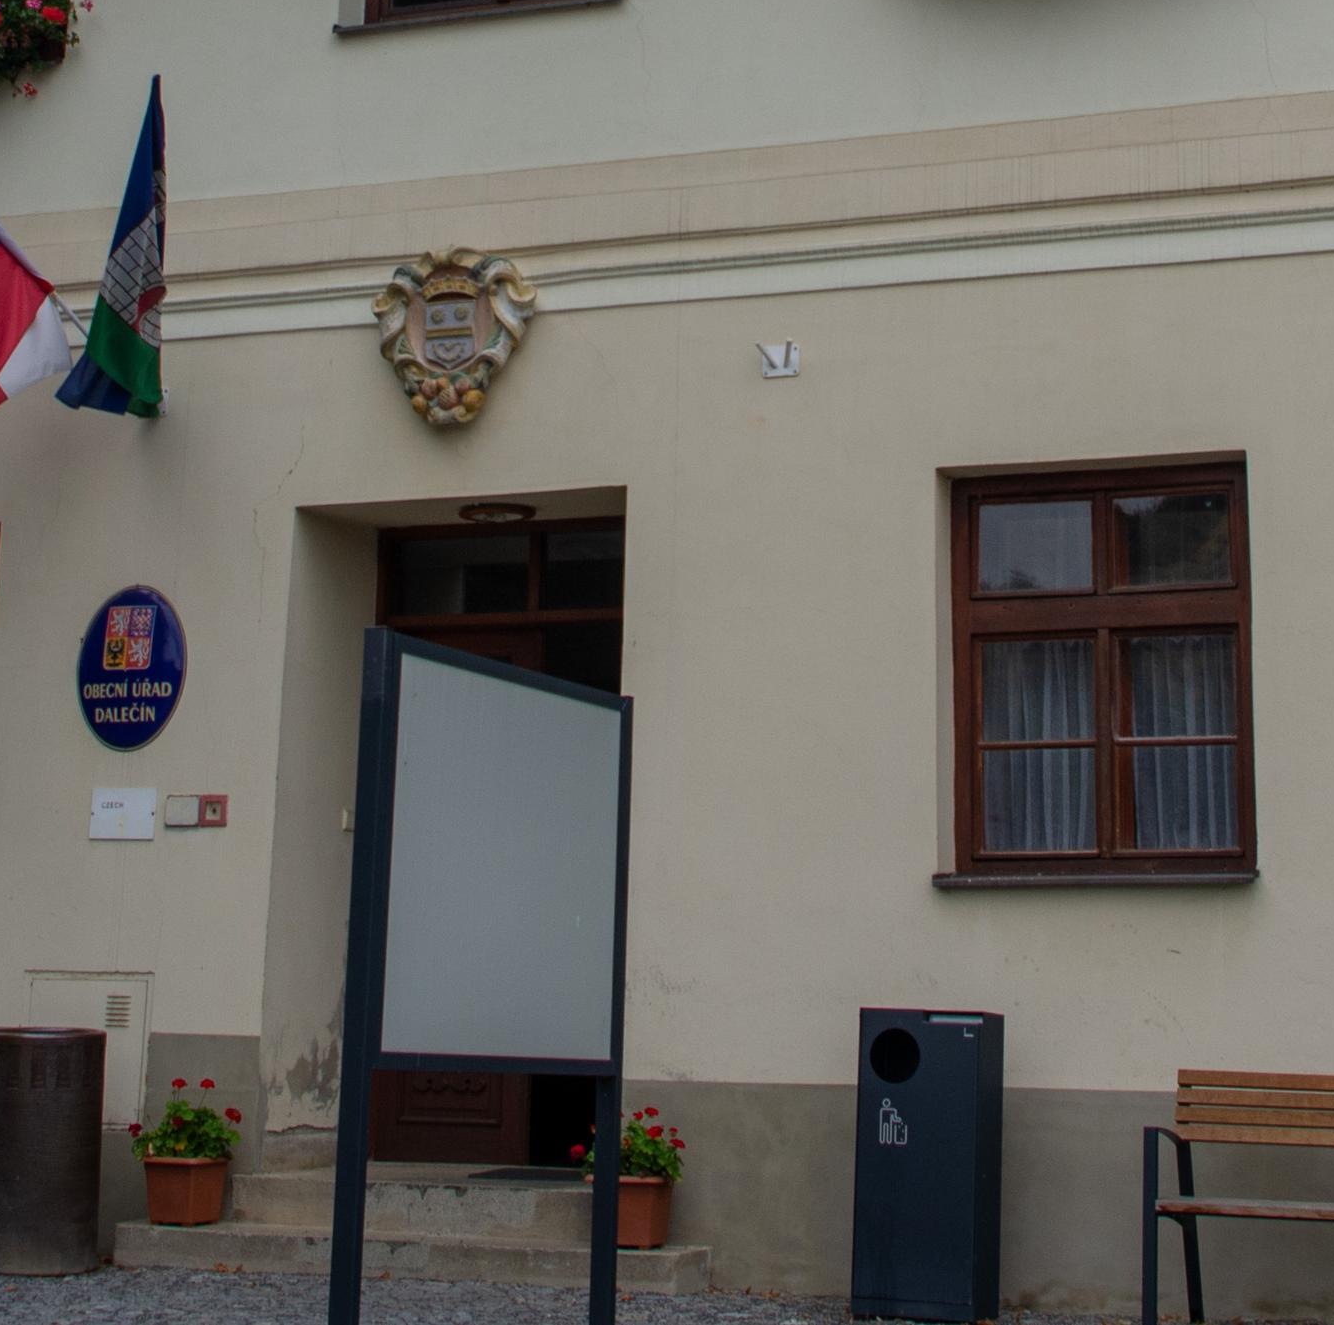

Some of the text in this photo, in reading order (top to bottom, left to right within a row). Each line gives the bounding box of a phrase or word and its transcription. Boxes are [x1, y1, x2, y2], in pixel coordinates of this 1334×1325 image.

[83, 678, 172, 698] OBECNÍ ÚŘAD
[94, 702, 155, 723] DALEČÍN
[101, 801, 124, 809] CZECH
